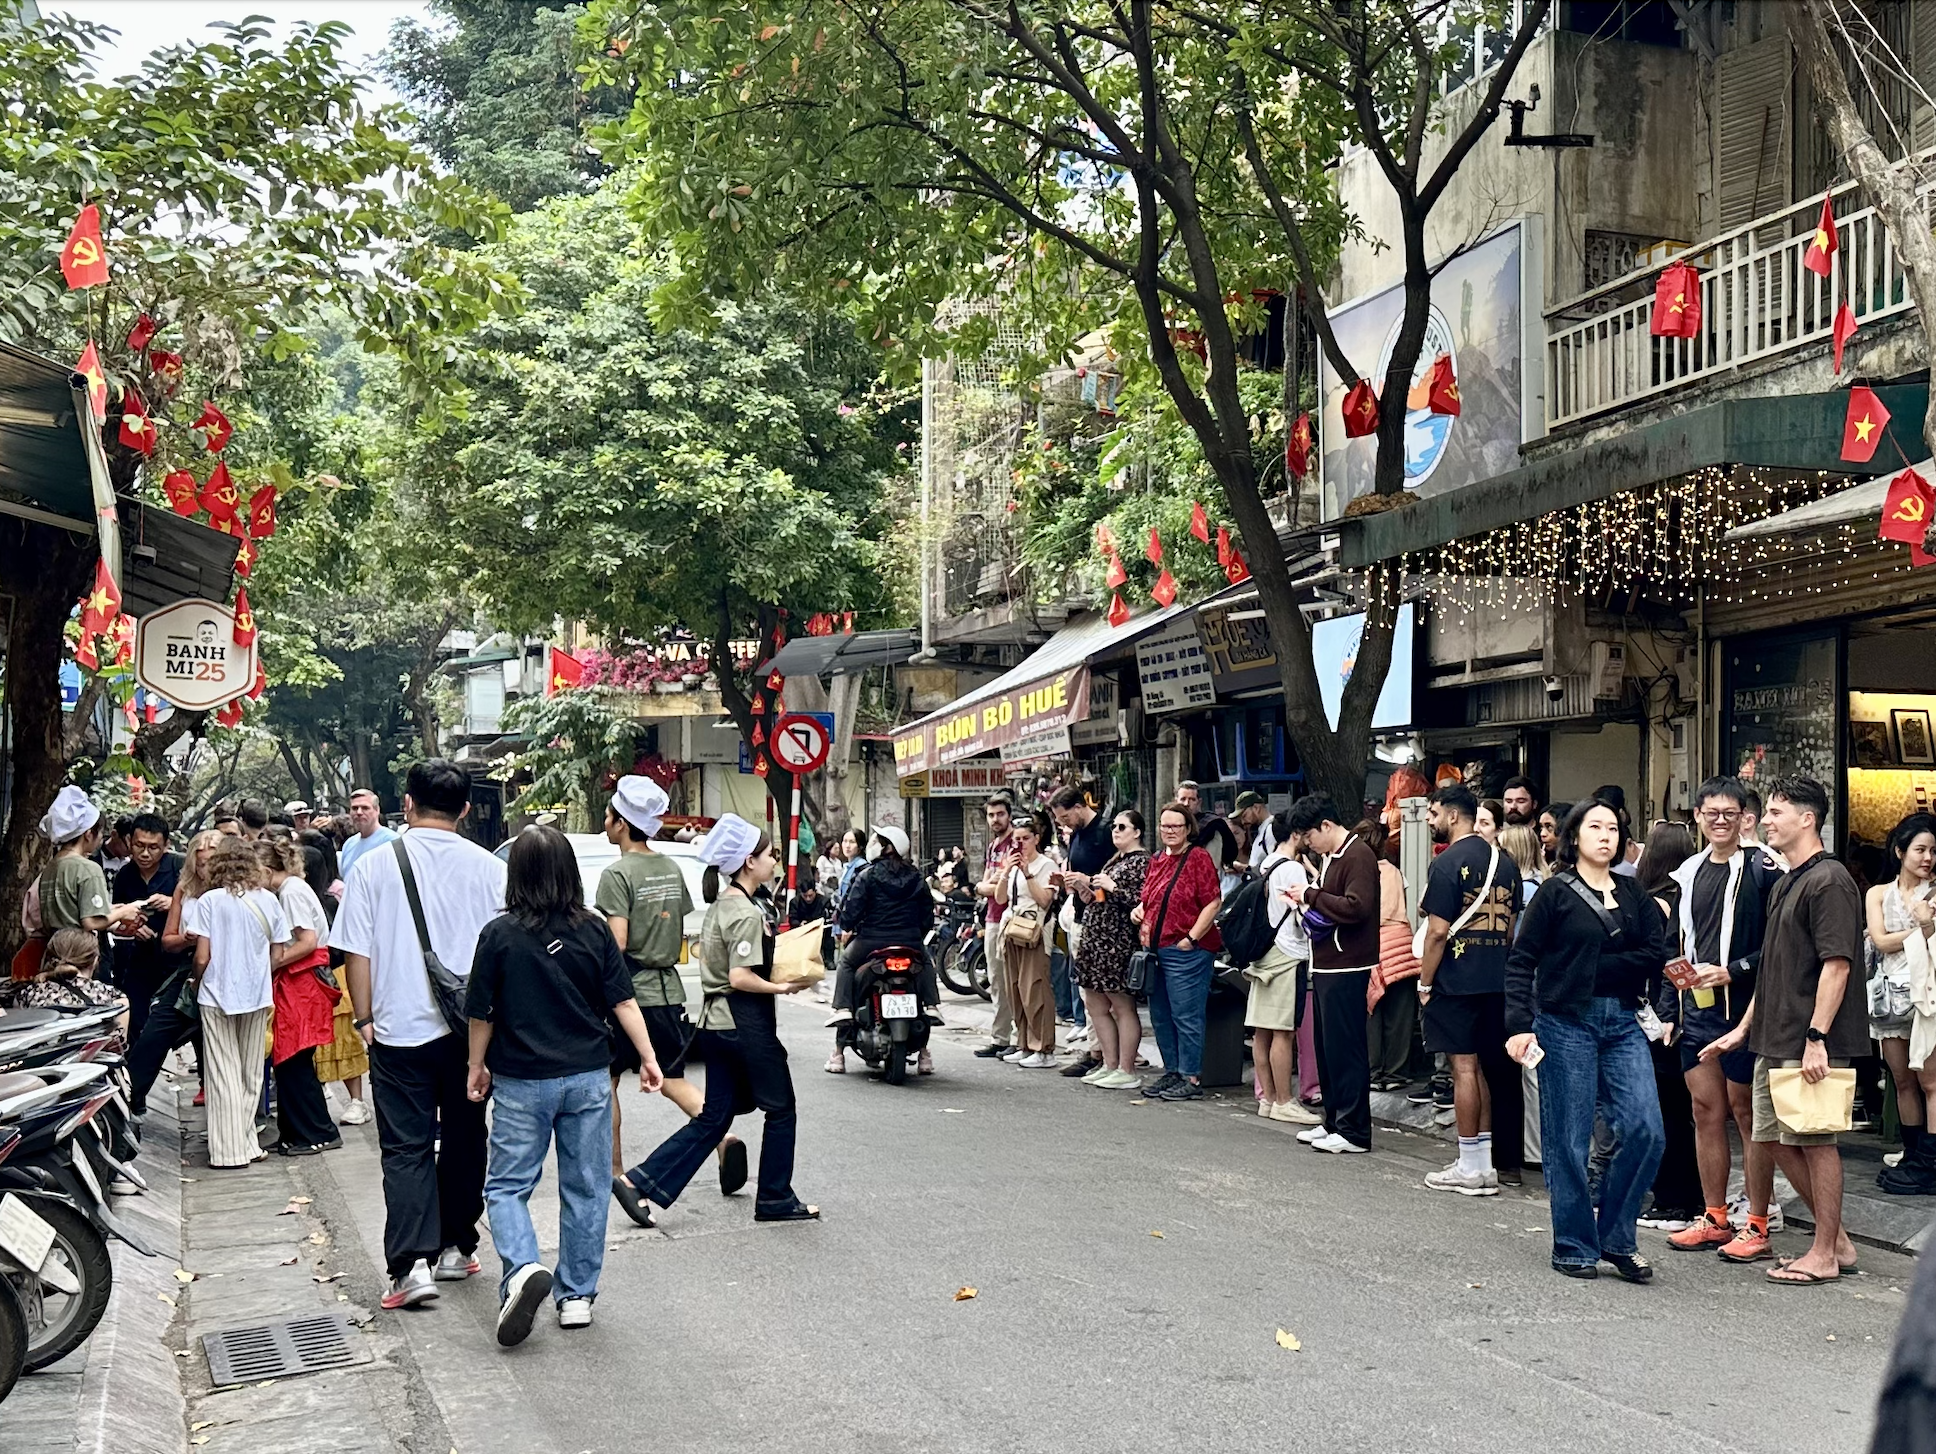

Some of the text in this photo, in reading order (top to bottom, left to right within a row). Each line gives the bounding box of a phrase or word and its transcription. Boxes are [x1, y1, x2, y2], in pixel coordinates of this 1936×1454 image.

[166, 643, 226, 660] BANH
[166, 660, 226, 682] MI 25
[936, 713, 977, 748] BÚN
[982, 696, 1013, 733] BÒ
[1019, 671, 1068, 720] HUẾ
[932, 766, 959, 787] KHOÁ
[961, 768, 987, 787] MINH
[1669, 963, 1688, 976] 021
